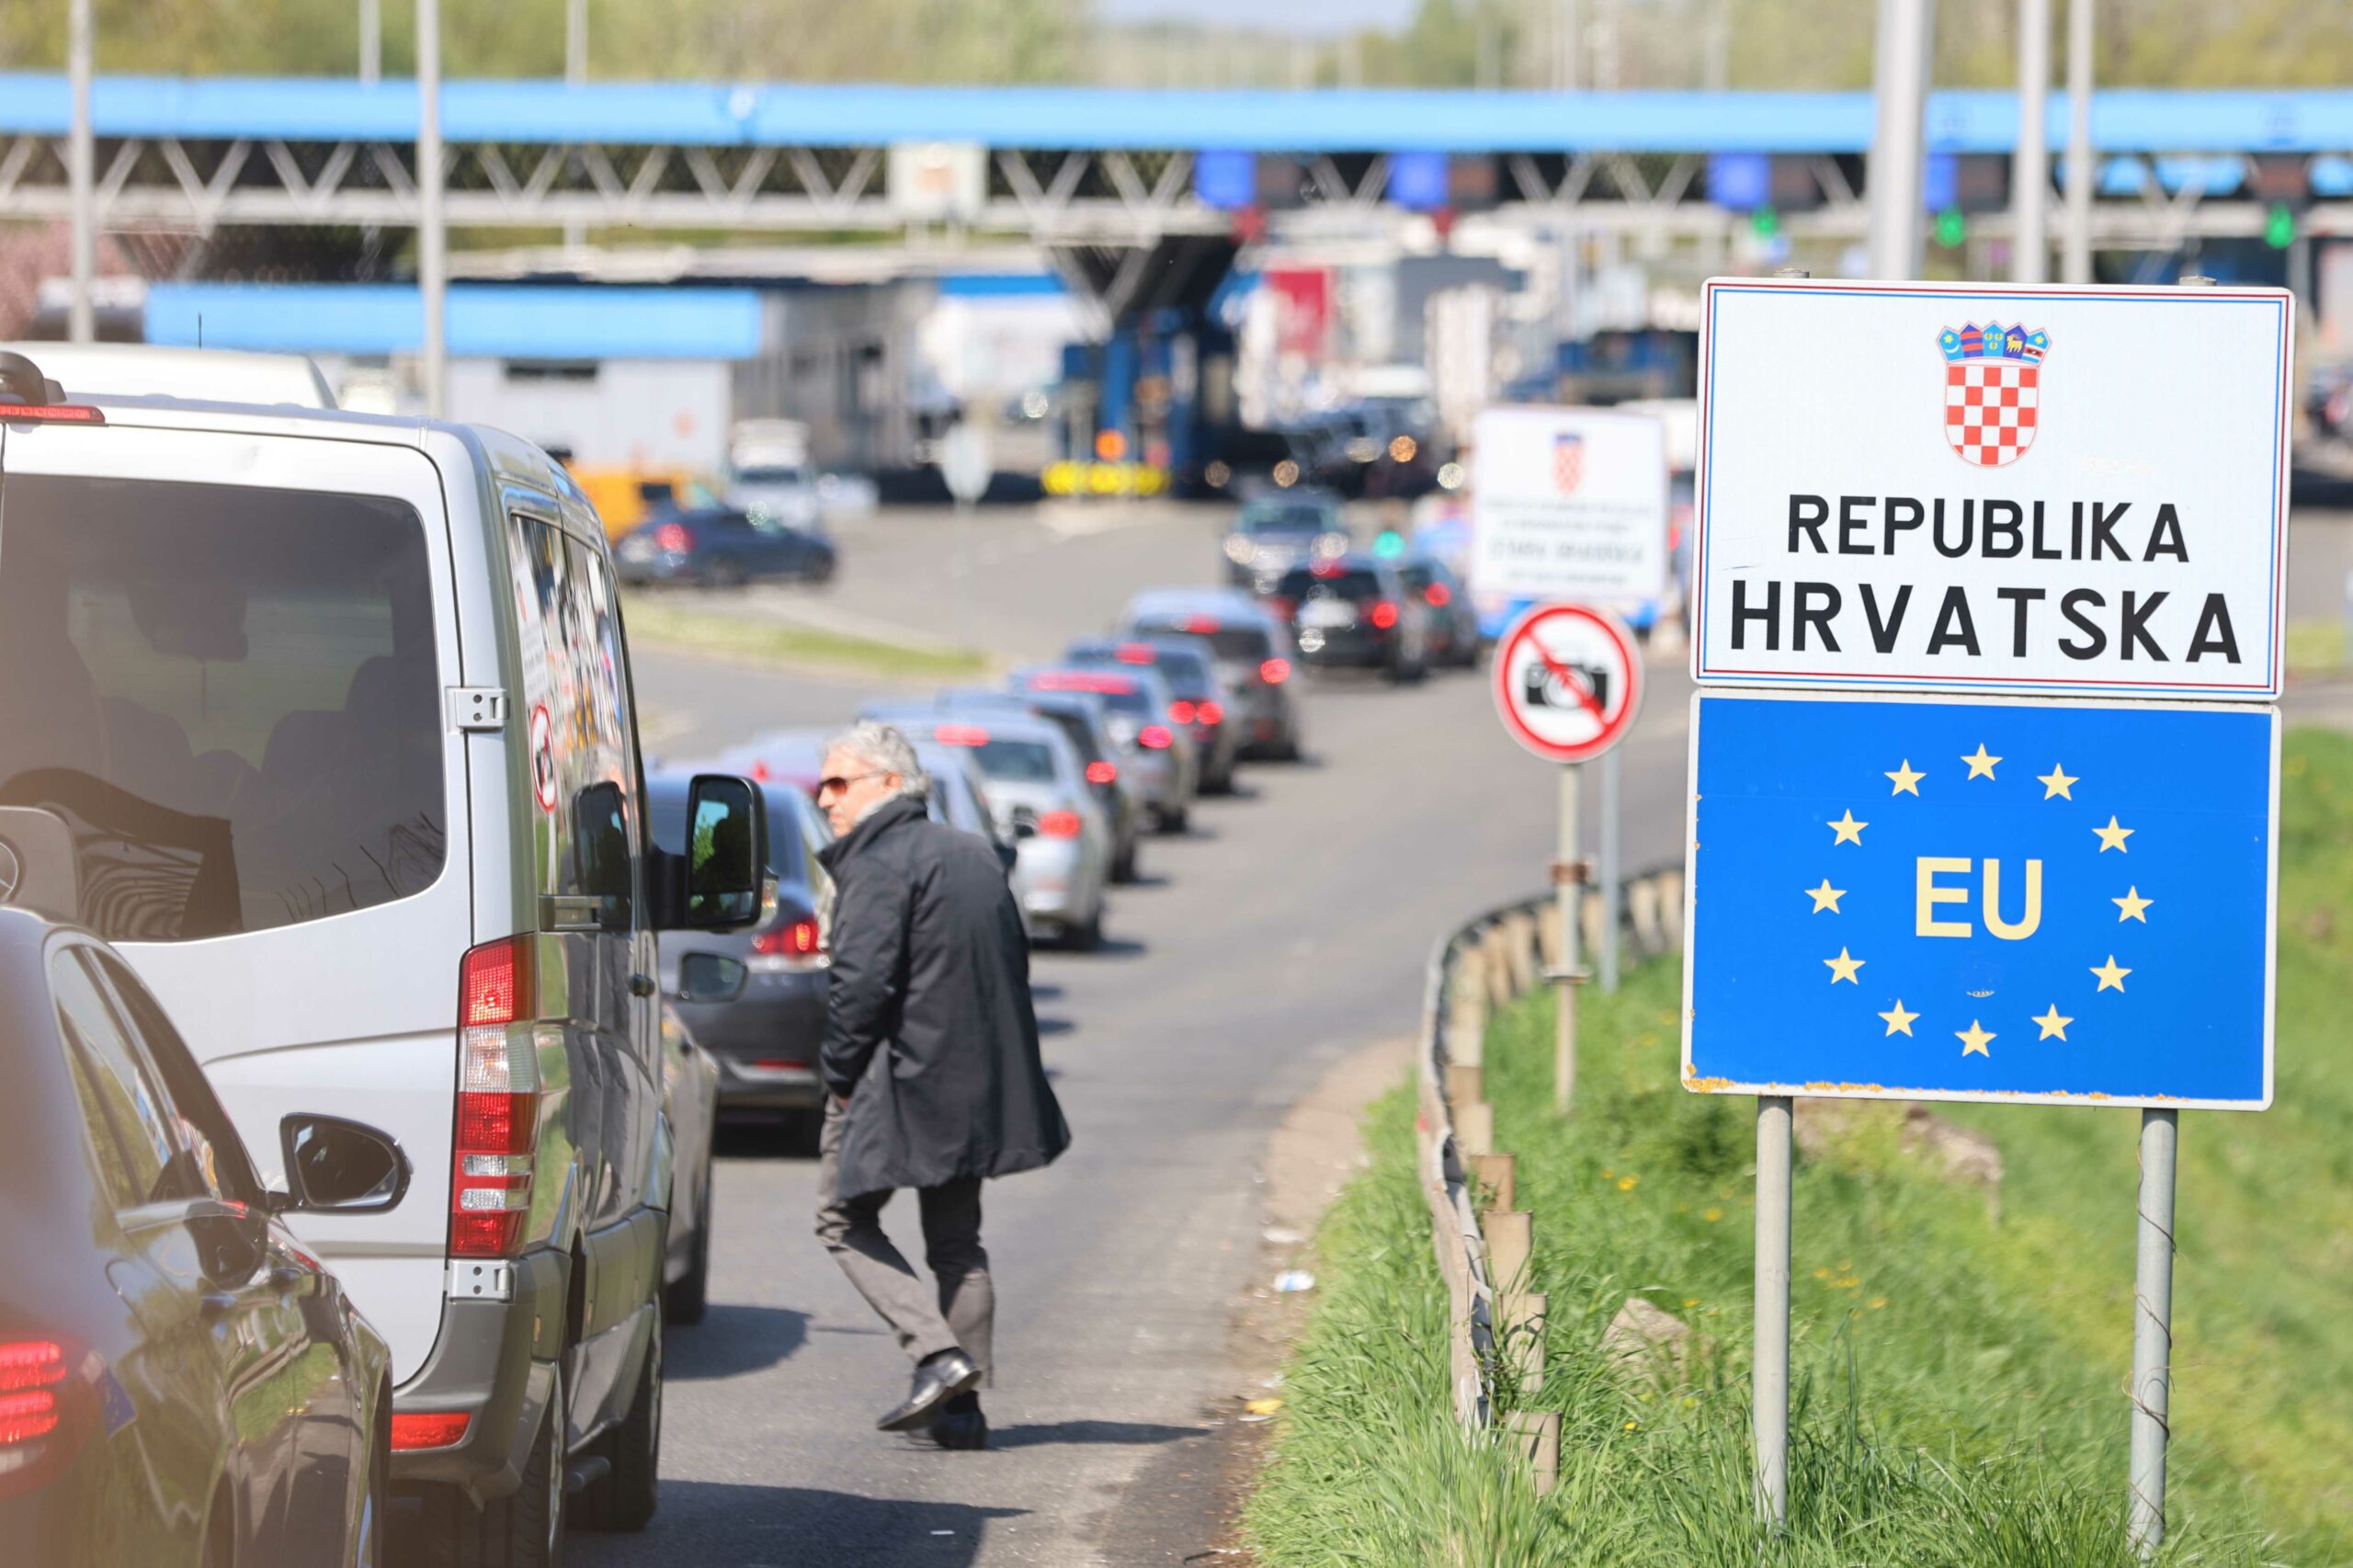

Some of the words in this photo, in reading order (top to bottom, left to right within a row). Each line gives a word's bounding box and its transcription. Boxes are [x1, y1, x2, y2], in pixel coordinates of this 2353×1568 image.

[1788, 494, 2189, 562] REPUBLIKA
[1731, 580, 2242, 664] HRVATSKA
[1915, 857, 2042, 940] EU
